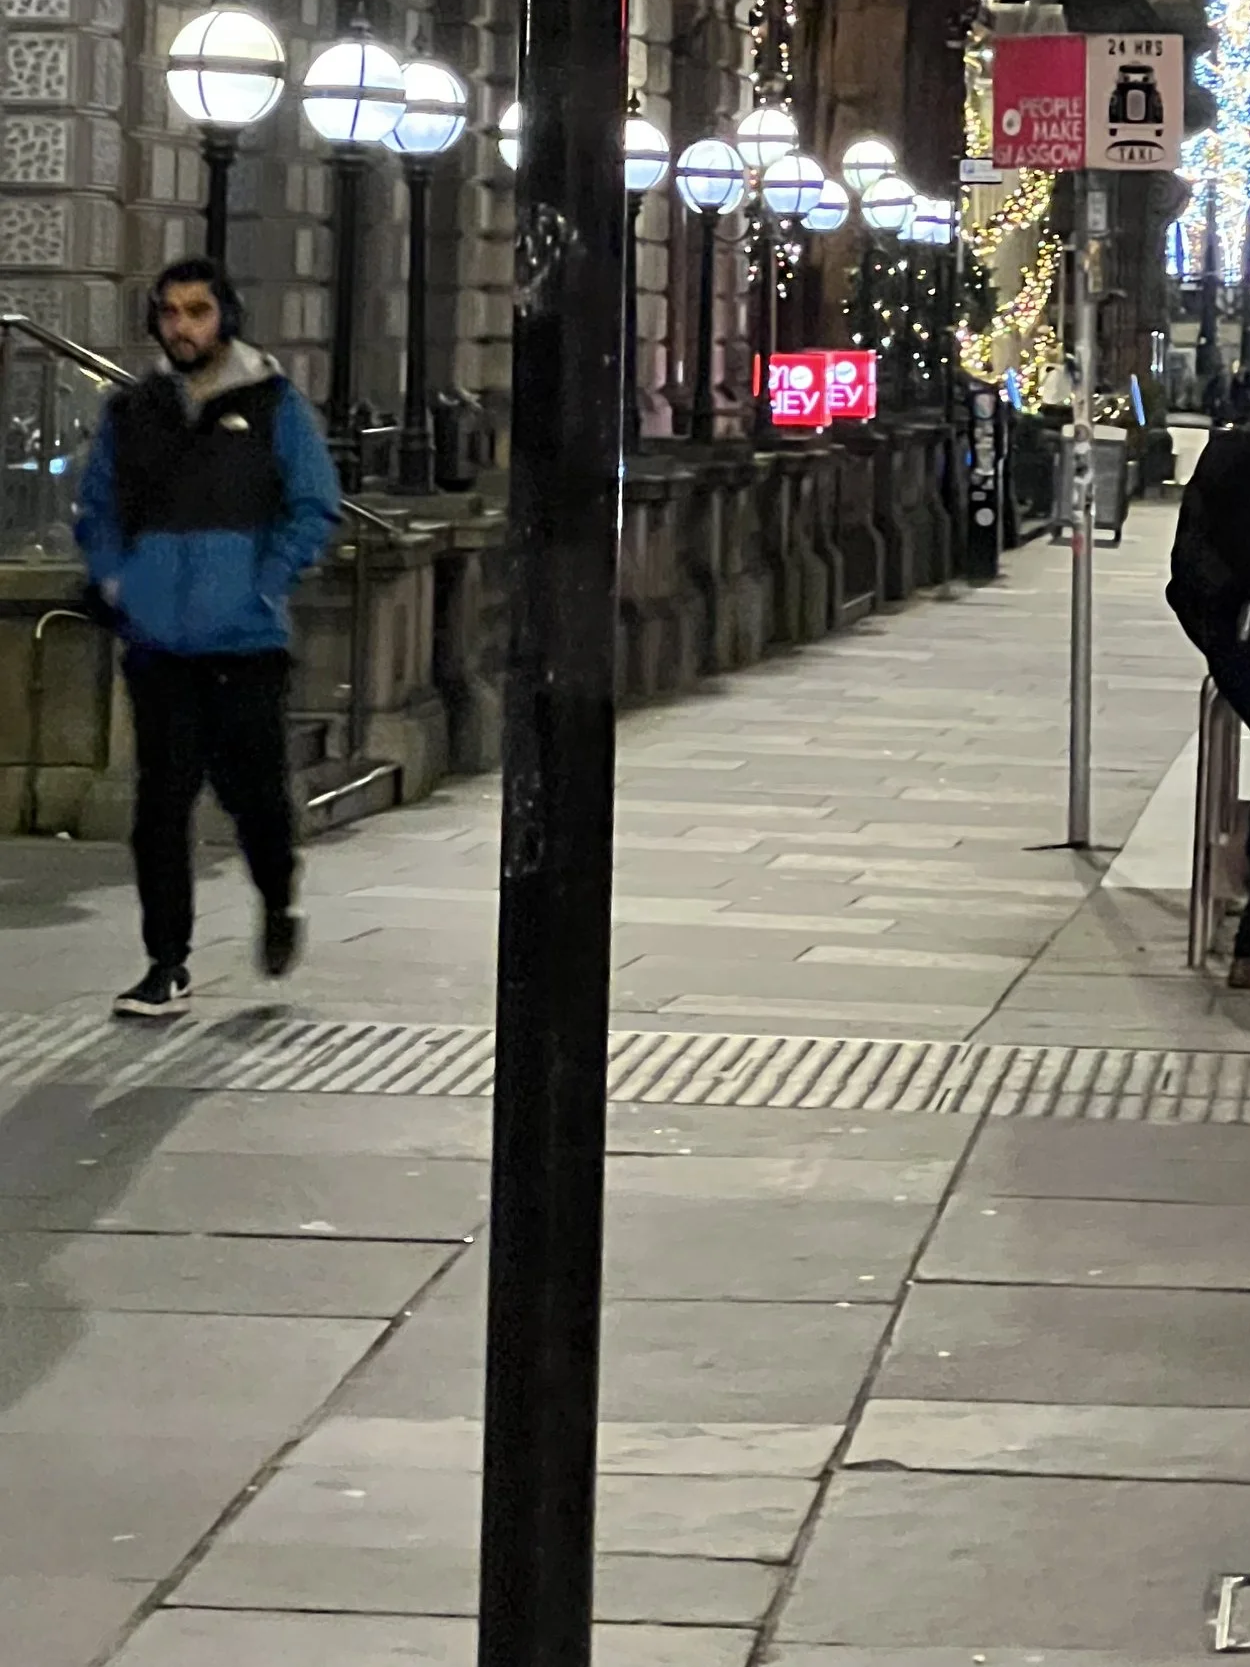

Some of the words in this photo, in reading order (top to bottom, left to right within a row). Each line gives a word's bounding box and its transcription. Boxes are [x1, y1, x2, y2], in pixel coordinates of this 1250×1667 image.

[1108, 38, 1126, 56] 24
[1134, 39, 1163, 57] HRS
[1018, 96, 1083, 118] PEOPLE
[1031, 120, 1083, 142] MAKE
[995, 143, 1082, 165] GLASGOW
[1118, 146, 1153, 161] TAXI
